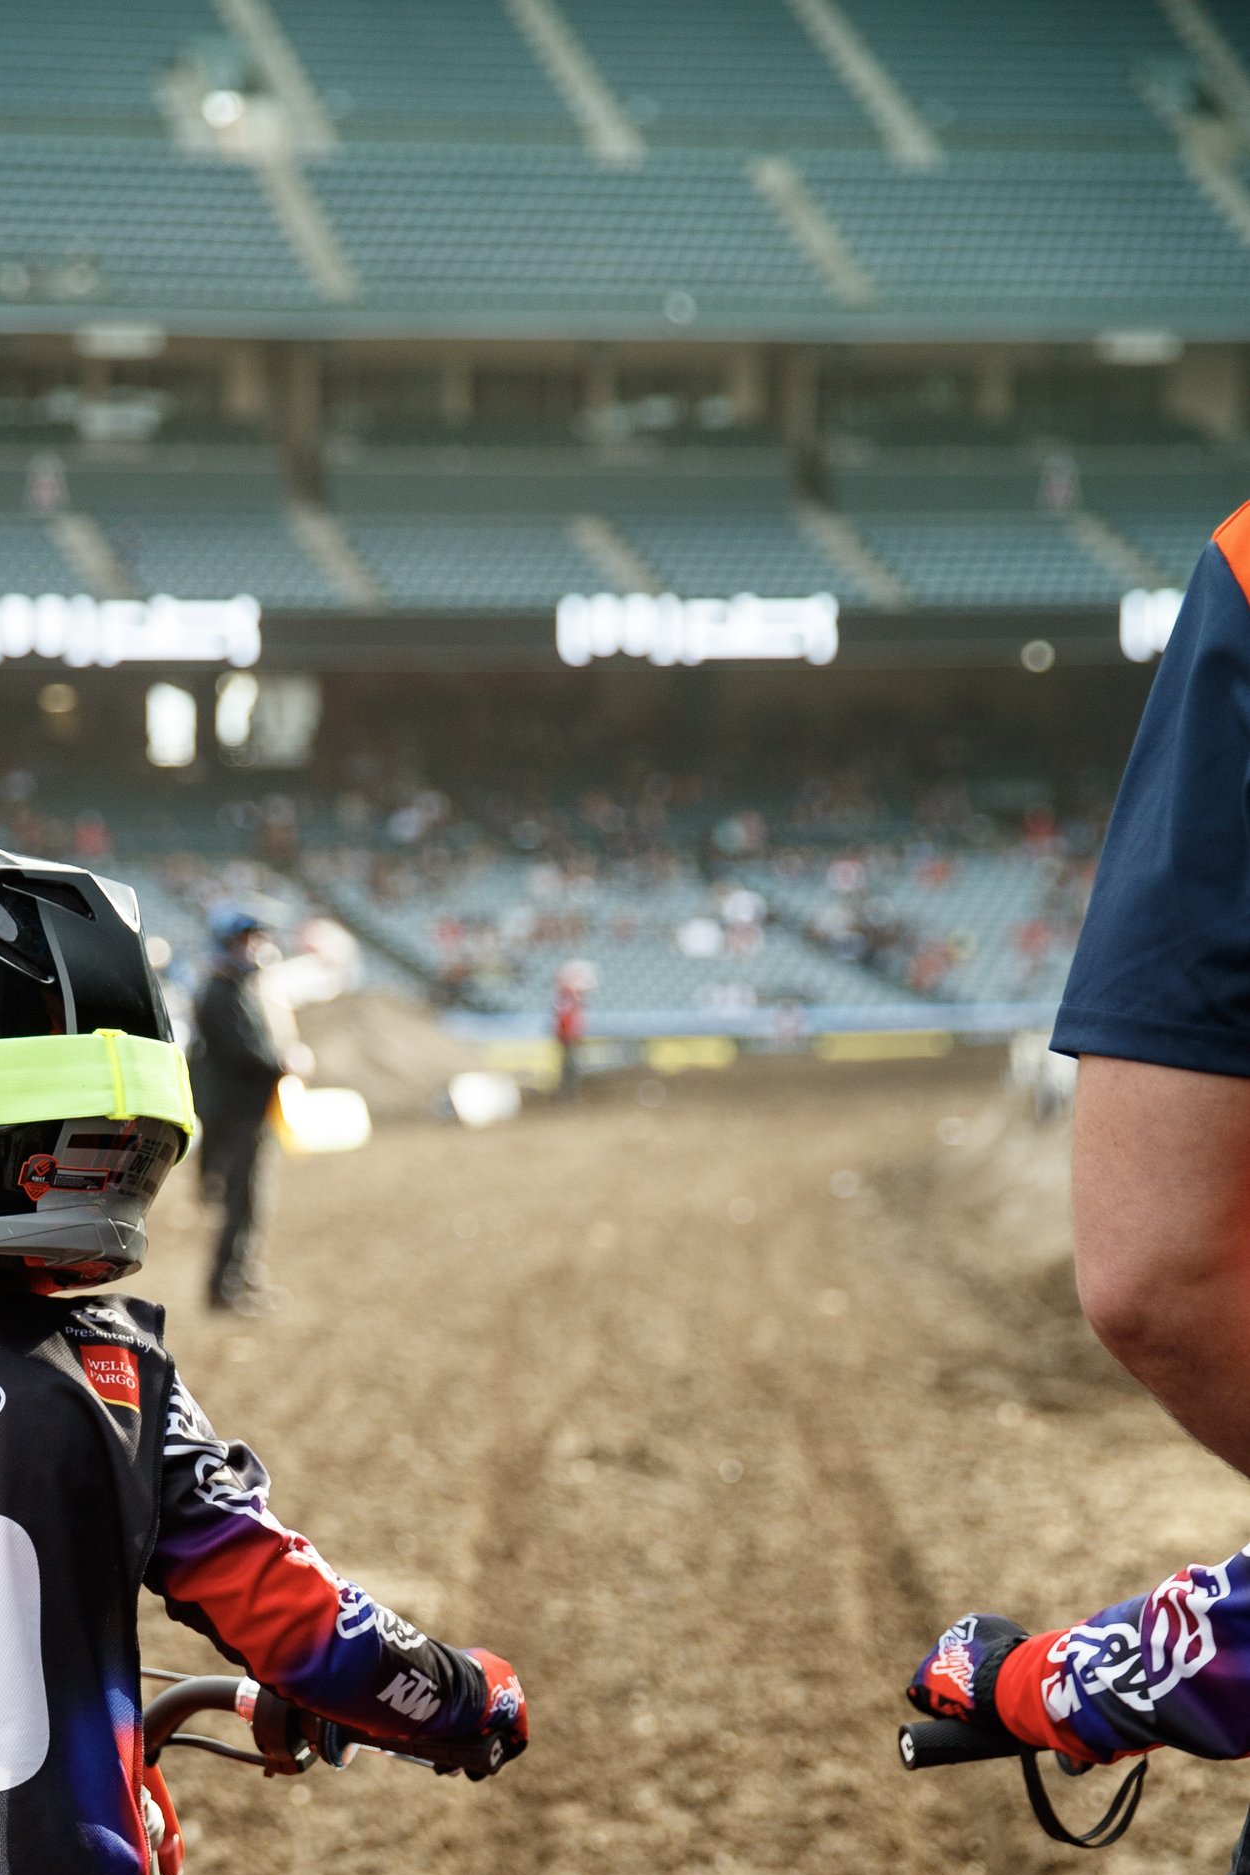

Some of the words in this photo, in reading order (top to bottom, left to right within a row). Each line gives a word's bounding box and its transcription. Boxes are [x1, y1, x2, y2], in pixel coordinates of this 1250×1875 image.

[65, 1326, 134, 1343] Presented
[137, 1338, 152, 1353] by
[86, 1358, 135, 1377] WELLS
[376, 1668, 442, 1723] KTM
